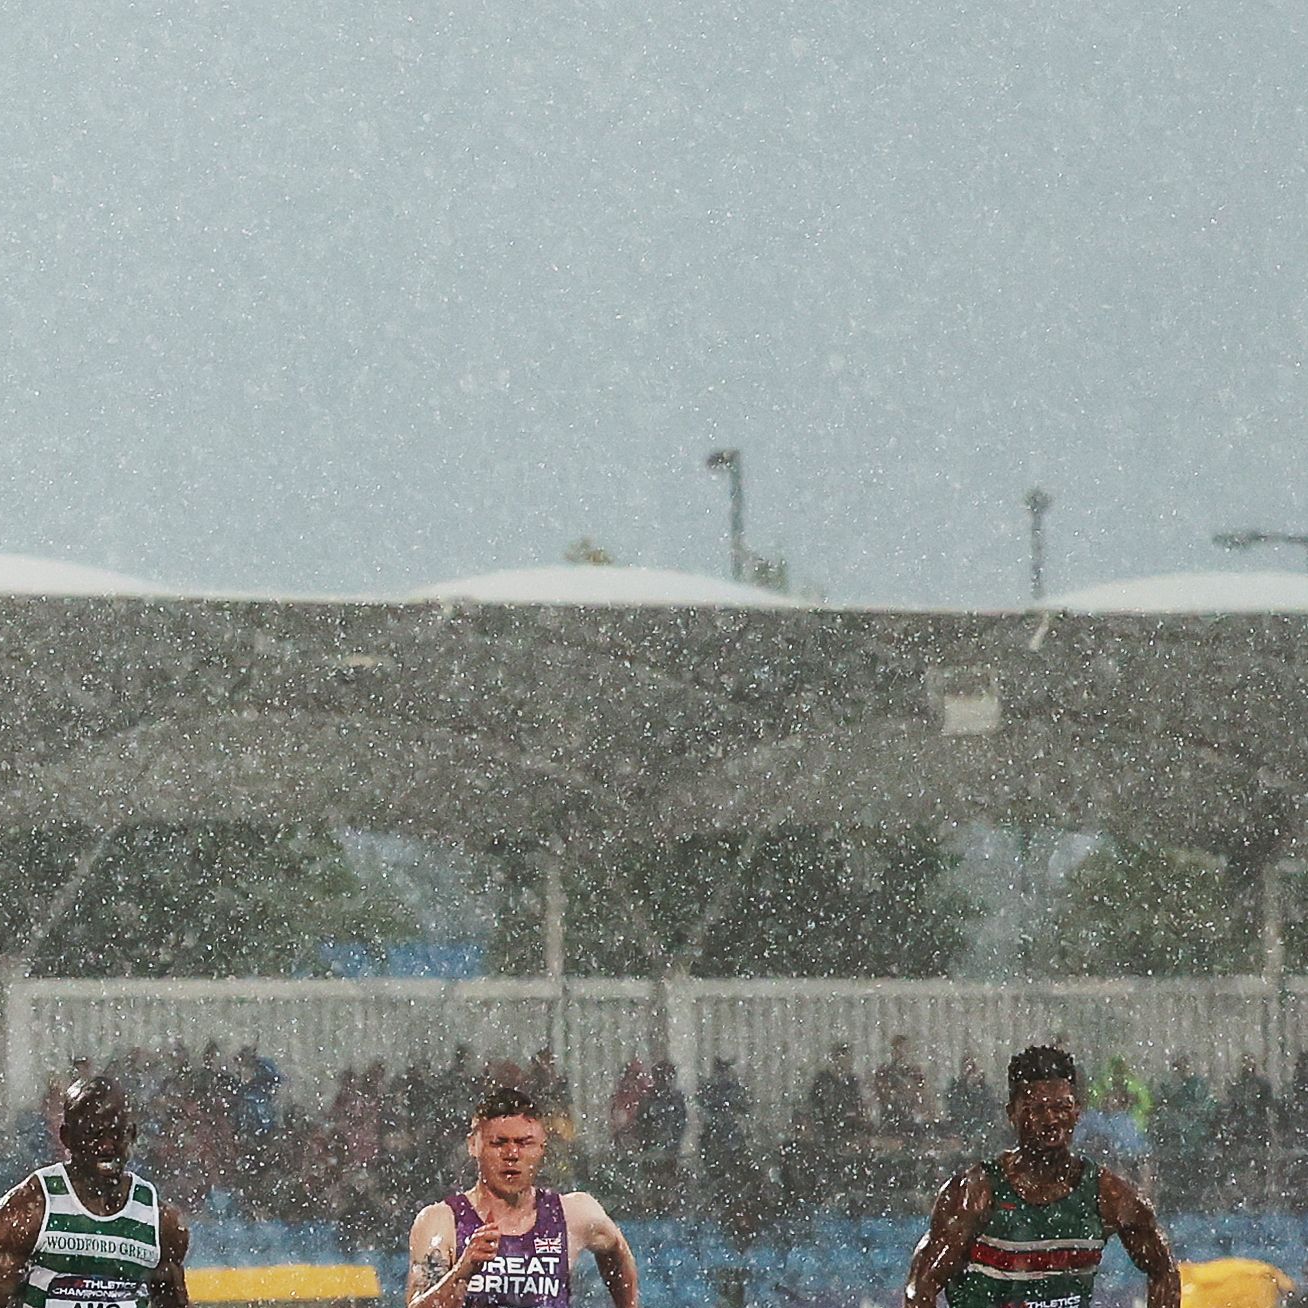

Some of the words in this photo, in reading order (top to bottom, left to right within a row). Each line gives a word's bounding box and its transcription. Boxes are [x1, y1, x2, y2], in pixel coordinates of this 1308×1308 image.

[46, 1236, 117, 1255] WOODFORD
[481, 1256, 560, 1275] REAT
[52, 1287, 132, 1299] CHAMPION
[466, 1275, 560, 1297] BRITAIN
